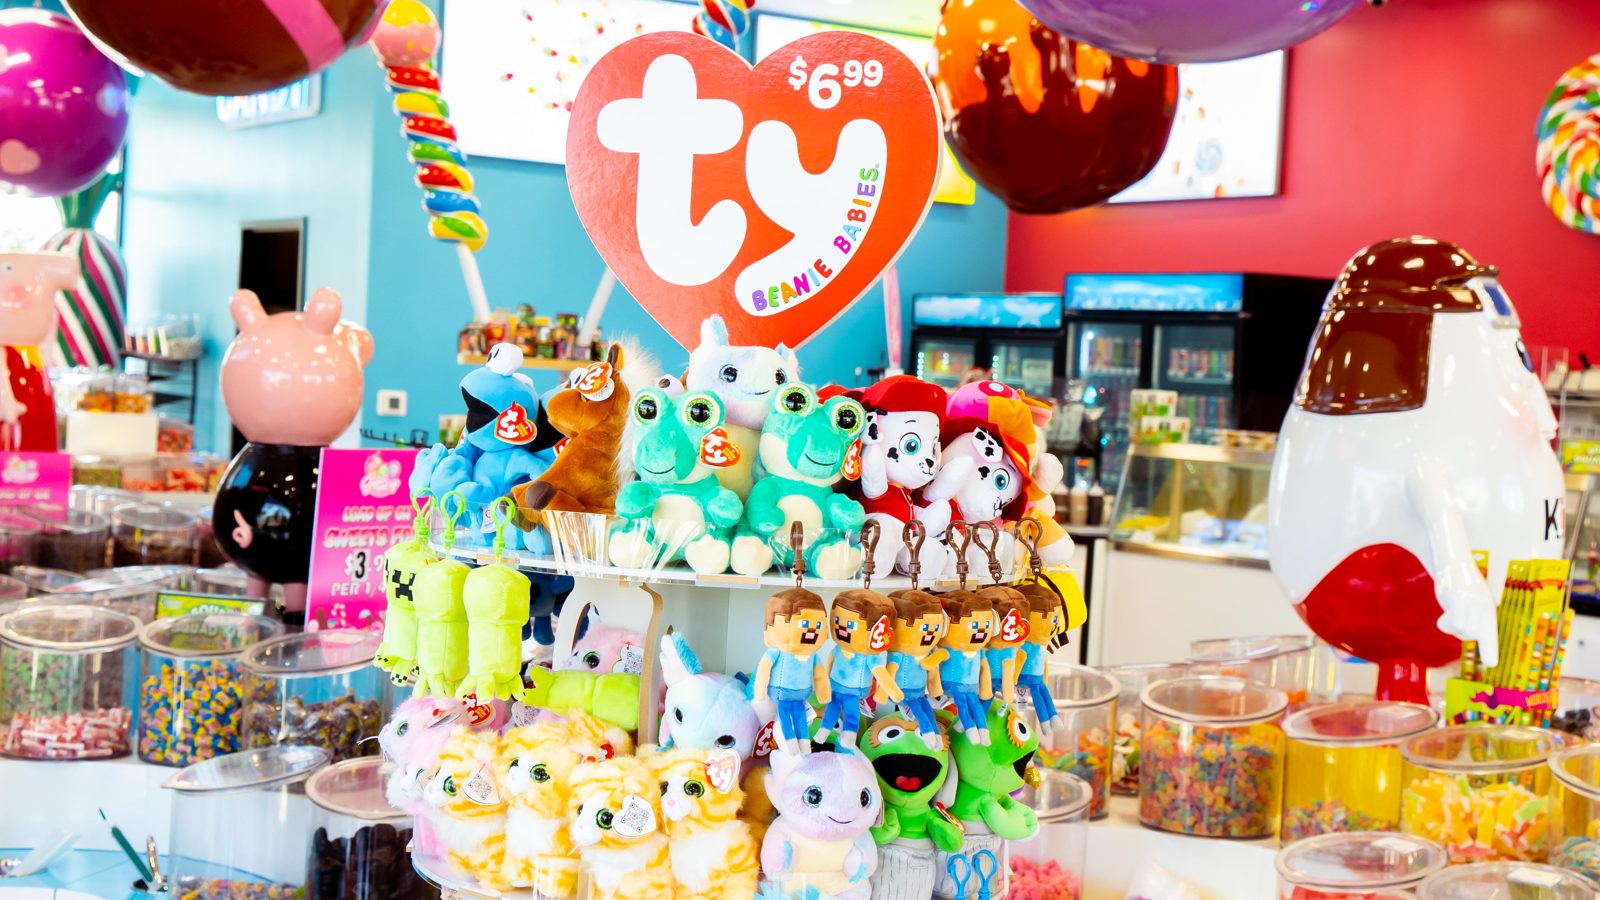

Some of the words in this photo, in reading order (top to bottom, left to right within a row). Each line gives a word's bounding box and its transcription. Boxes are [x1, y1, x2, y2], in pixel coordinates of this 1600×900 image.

[597, 54, 888, 317] ty
[752, 258, 833, 312] BEANIE
[833, 167, 880, 255] BABIES
[498, 410, 520, 439] ty
[704, 433, 728, 464] ty
[844, 443, 858, 475] ty
[342, 505, 374, 522] LOAD
[376, 505, 394, 522] UP
[323, 526, 388, 548] SWEETS
[331, 582, 360, 596] PER
[871, 622, 885, 649] ty
[1003, 615, 1020, 641] ty
[756, 728, 773, 756] ty
[706, 764, 732, 793] ty
